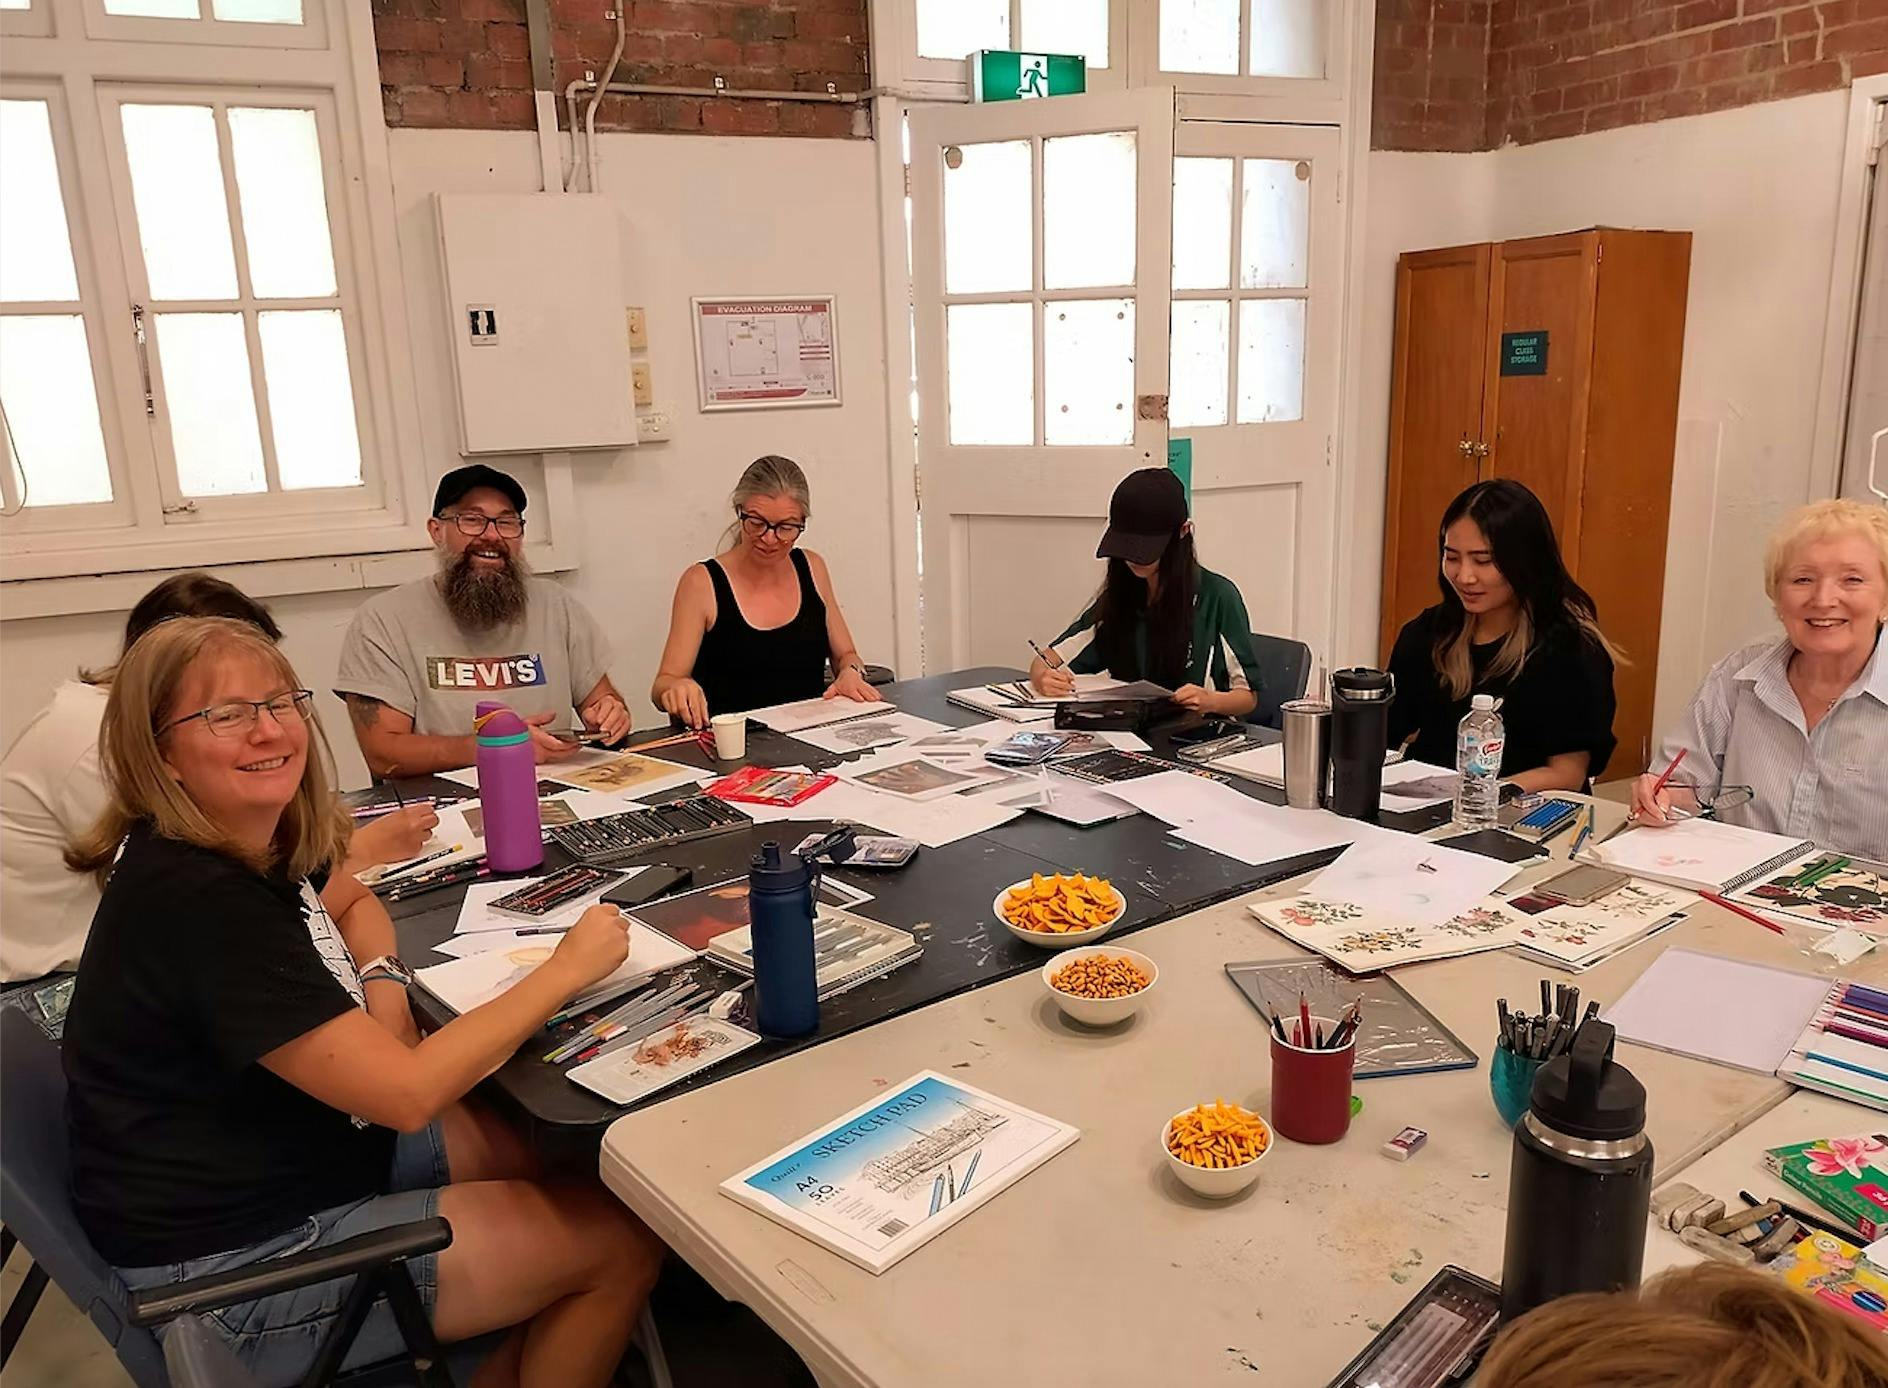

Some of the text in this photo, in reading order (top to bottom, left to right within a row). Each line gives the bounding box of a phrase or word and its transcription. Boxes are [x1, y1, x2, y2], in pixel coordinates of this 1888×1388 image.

[717, 305, 812, 314] EVACUATION DIAGRAM
[437, 659, 537, 686] LEVI'S
[811, 1093, 927, 1158] SKETCH PAD
[796, 1175, 818, 1193] A4
[809, 1184, 834, 1201] 50
